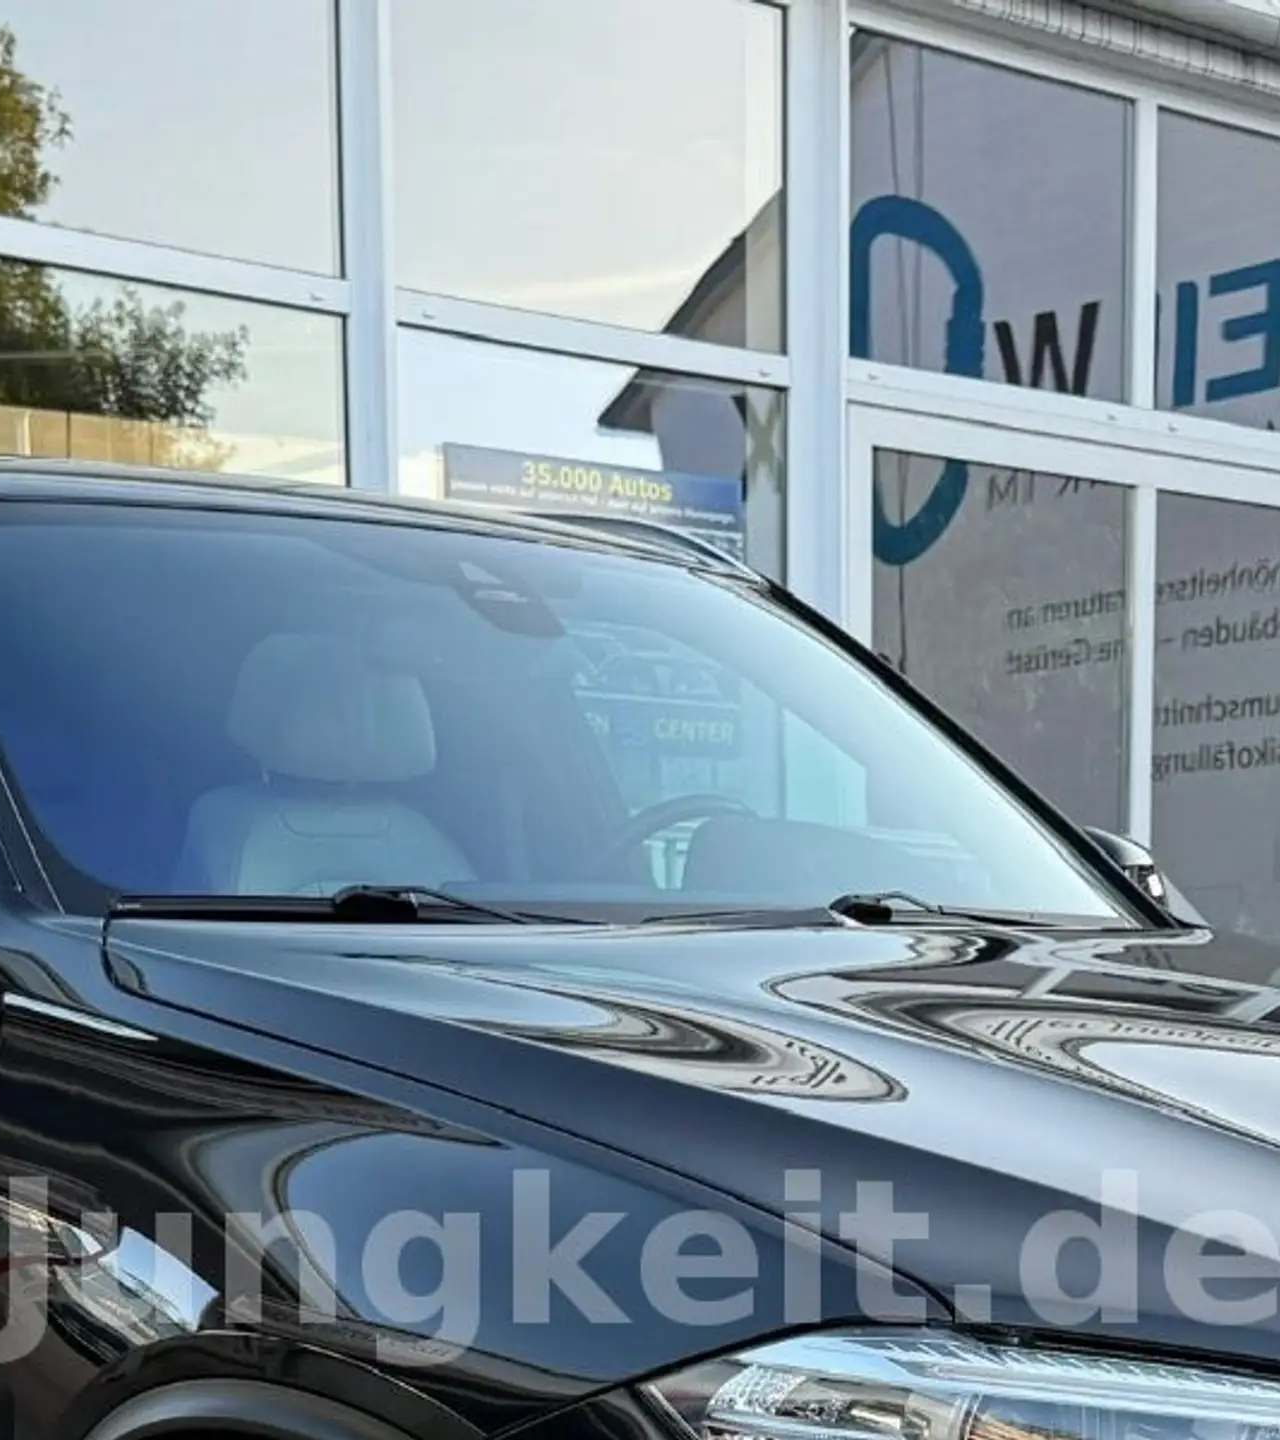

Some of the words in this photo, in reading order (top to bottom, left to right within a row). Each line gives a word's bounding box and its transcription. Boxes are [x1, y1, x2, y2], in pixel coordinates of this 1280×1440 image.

[522, 461, 604, 491] 35.000
[608, 473, 674, 503] Autos
[654, 716, 736, 746] CENTER
